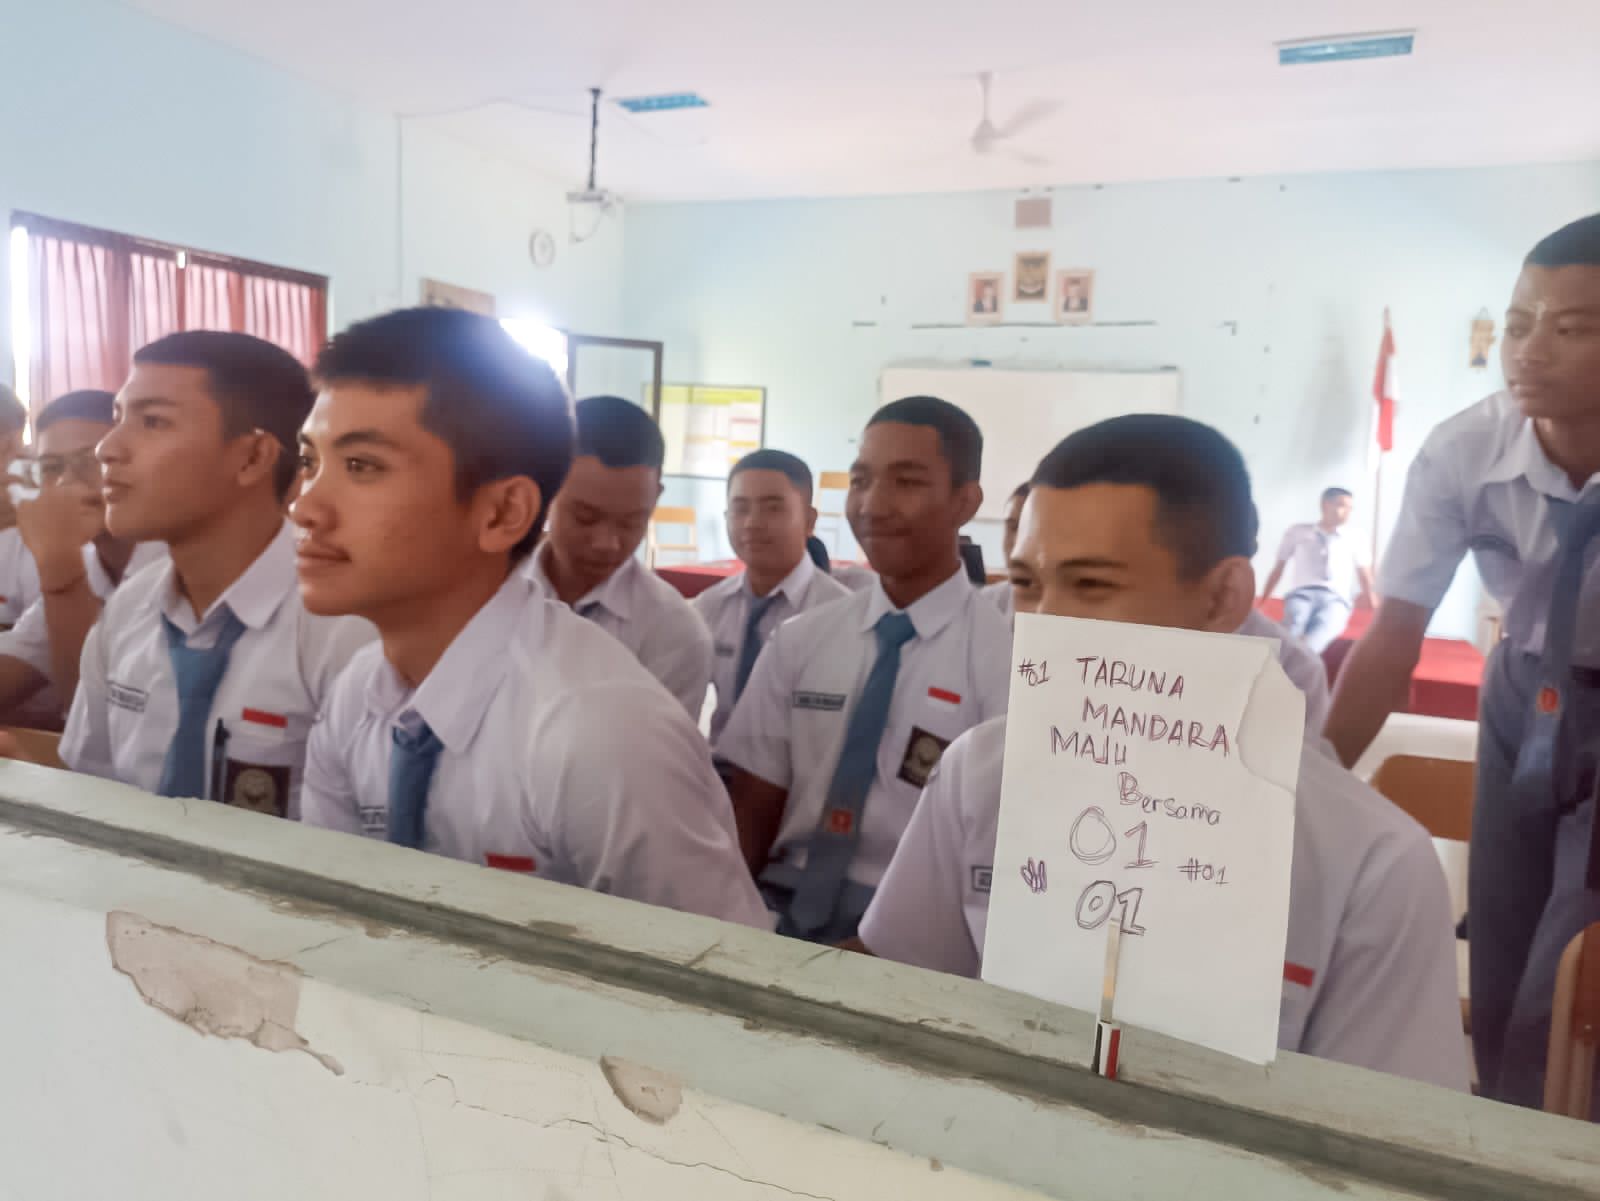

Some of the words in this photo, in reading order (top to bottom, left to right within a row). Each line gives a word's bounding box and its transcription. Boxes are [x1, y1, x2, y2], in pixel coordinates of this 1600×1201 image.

[1017, 659, 1050, 686] #01
[1076, 656, 1184, 699] TARUNA
[1050, 725, 1127, 765] MAJU
[1082, 696, 1230, 757] MANDARA
[1118, 771, 1221, 825] Bersama
[1069, 806, 1159, 869] 01
[1178, 857, 1230, 885] #01
[1075, 879, 1147, 936] 01
